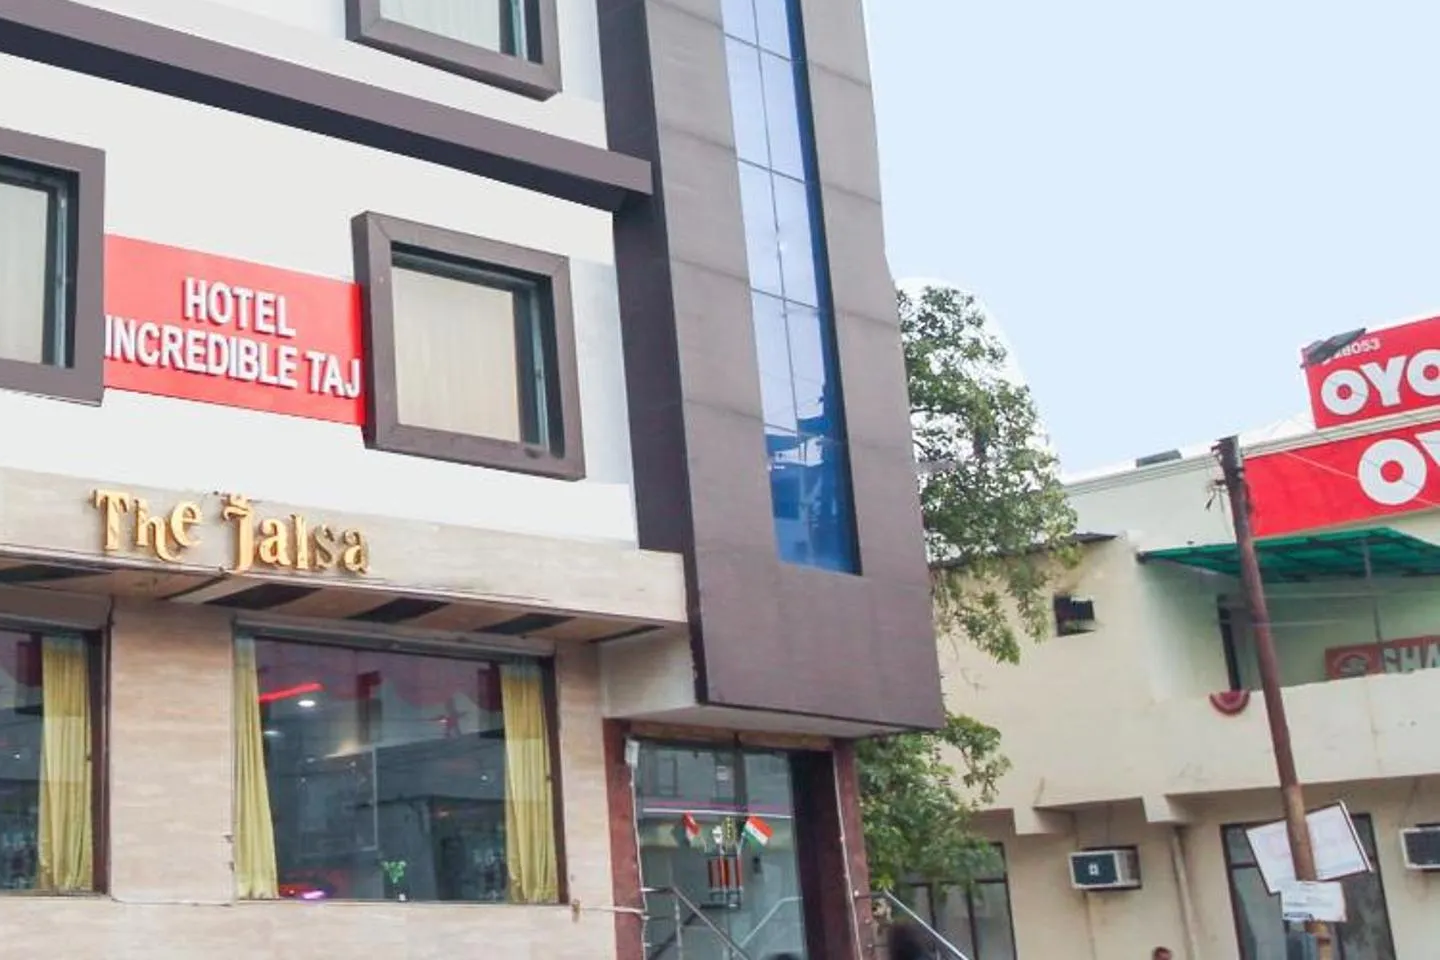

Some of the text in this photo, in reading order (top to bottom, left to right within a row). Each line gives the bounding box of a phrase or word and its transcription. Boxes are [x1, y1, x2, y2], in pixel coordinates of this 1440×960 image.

[184, 276, 296, 337] HOTEL
[105, 315, 360, 399] INCREDIBLE TAJ
[1321, 349, 1440, 415] OYO
[89, 488, 371, 574] The Jalsa
